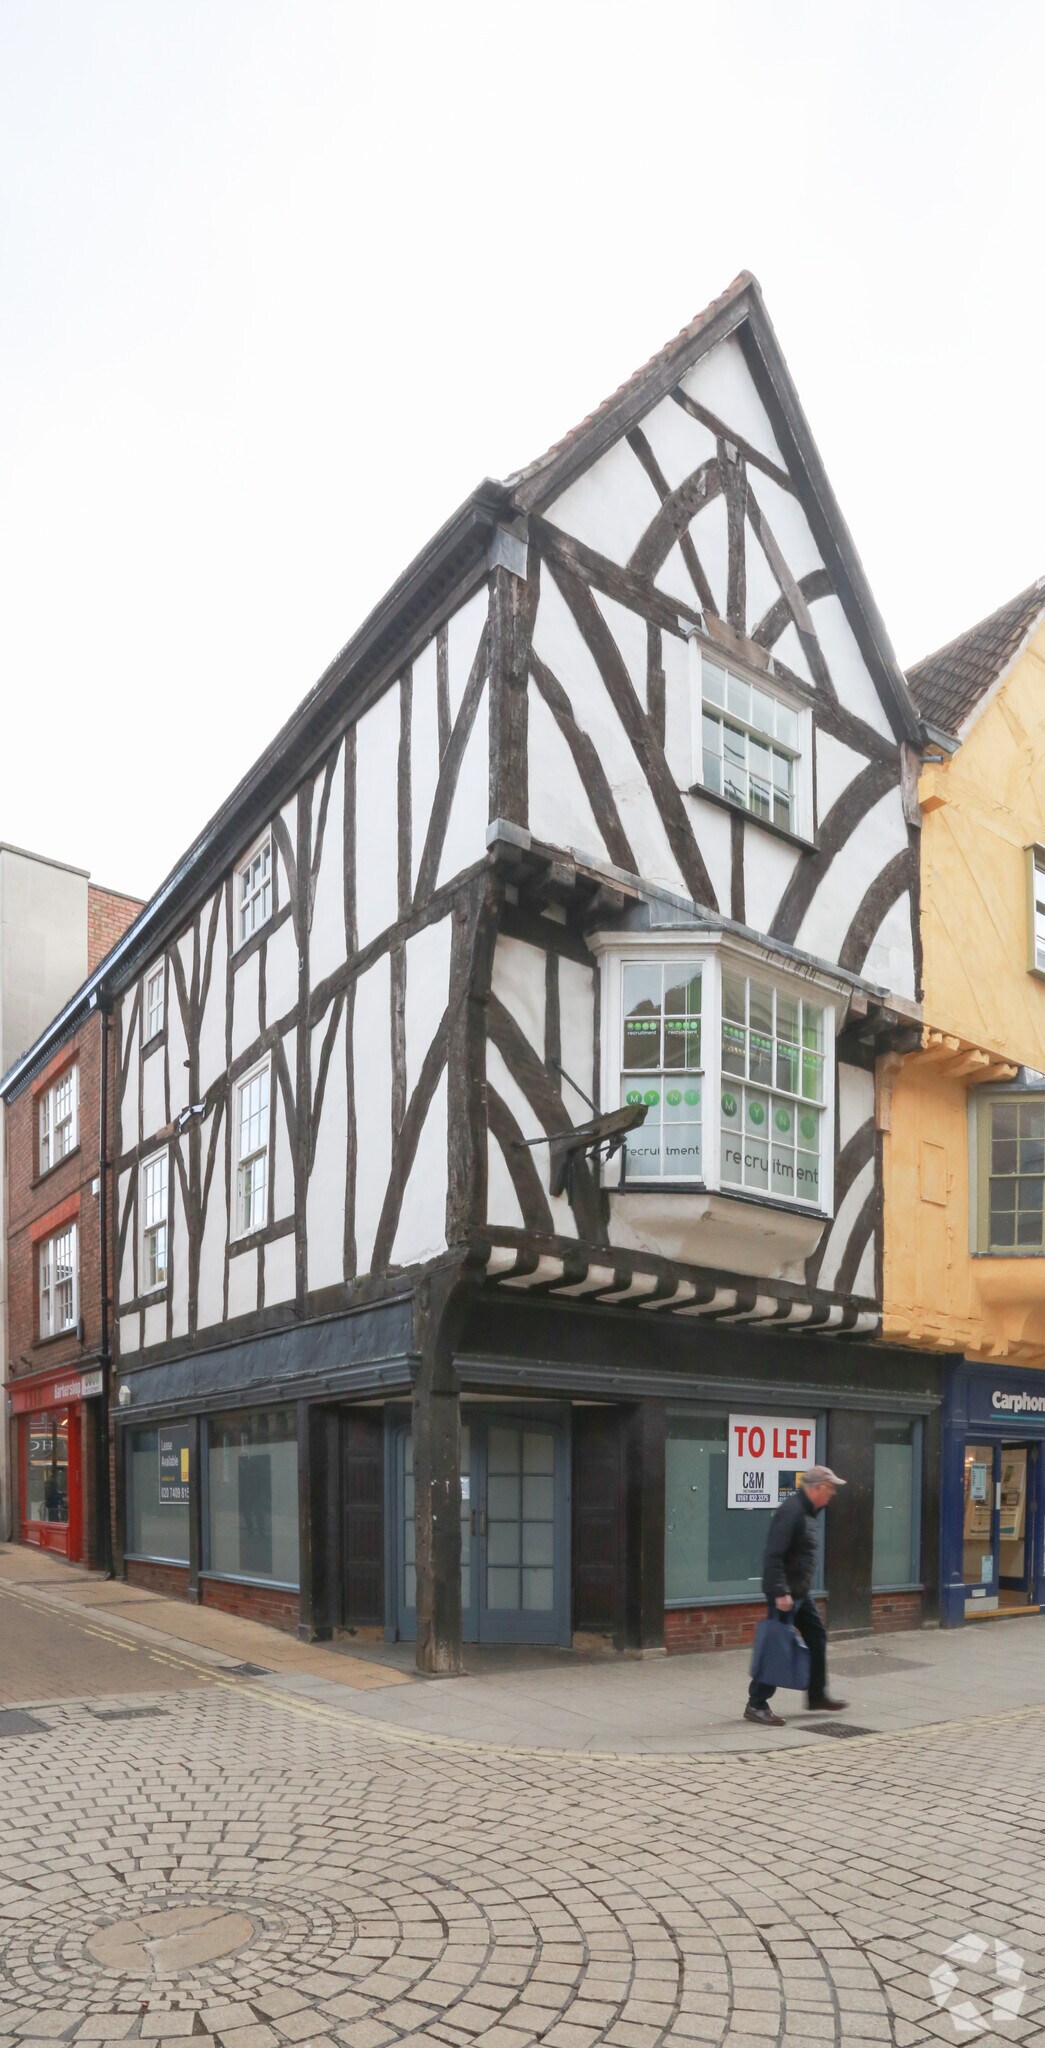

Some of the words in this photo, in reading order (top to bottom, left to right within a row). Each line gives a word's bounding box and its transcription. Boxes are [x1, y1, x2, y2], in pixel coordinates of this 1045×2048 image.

[725, 1149, 818, 1184] recruitment
[54, 1380, 80, 1399] Barbershop
[161, 1440, 172, 1451] Lease
[734, 1426, 765, 1458] TO
[773, 1428, 811, 1459] LET
[743, 1471, 764, 1489] C&M
[737, 1494, 749, 1502] 0161
[749, 1494, 757, 1502] 832
[758, 1494, 769, 1502] 3375
